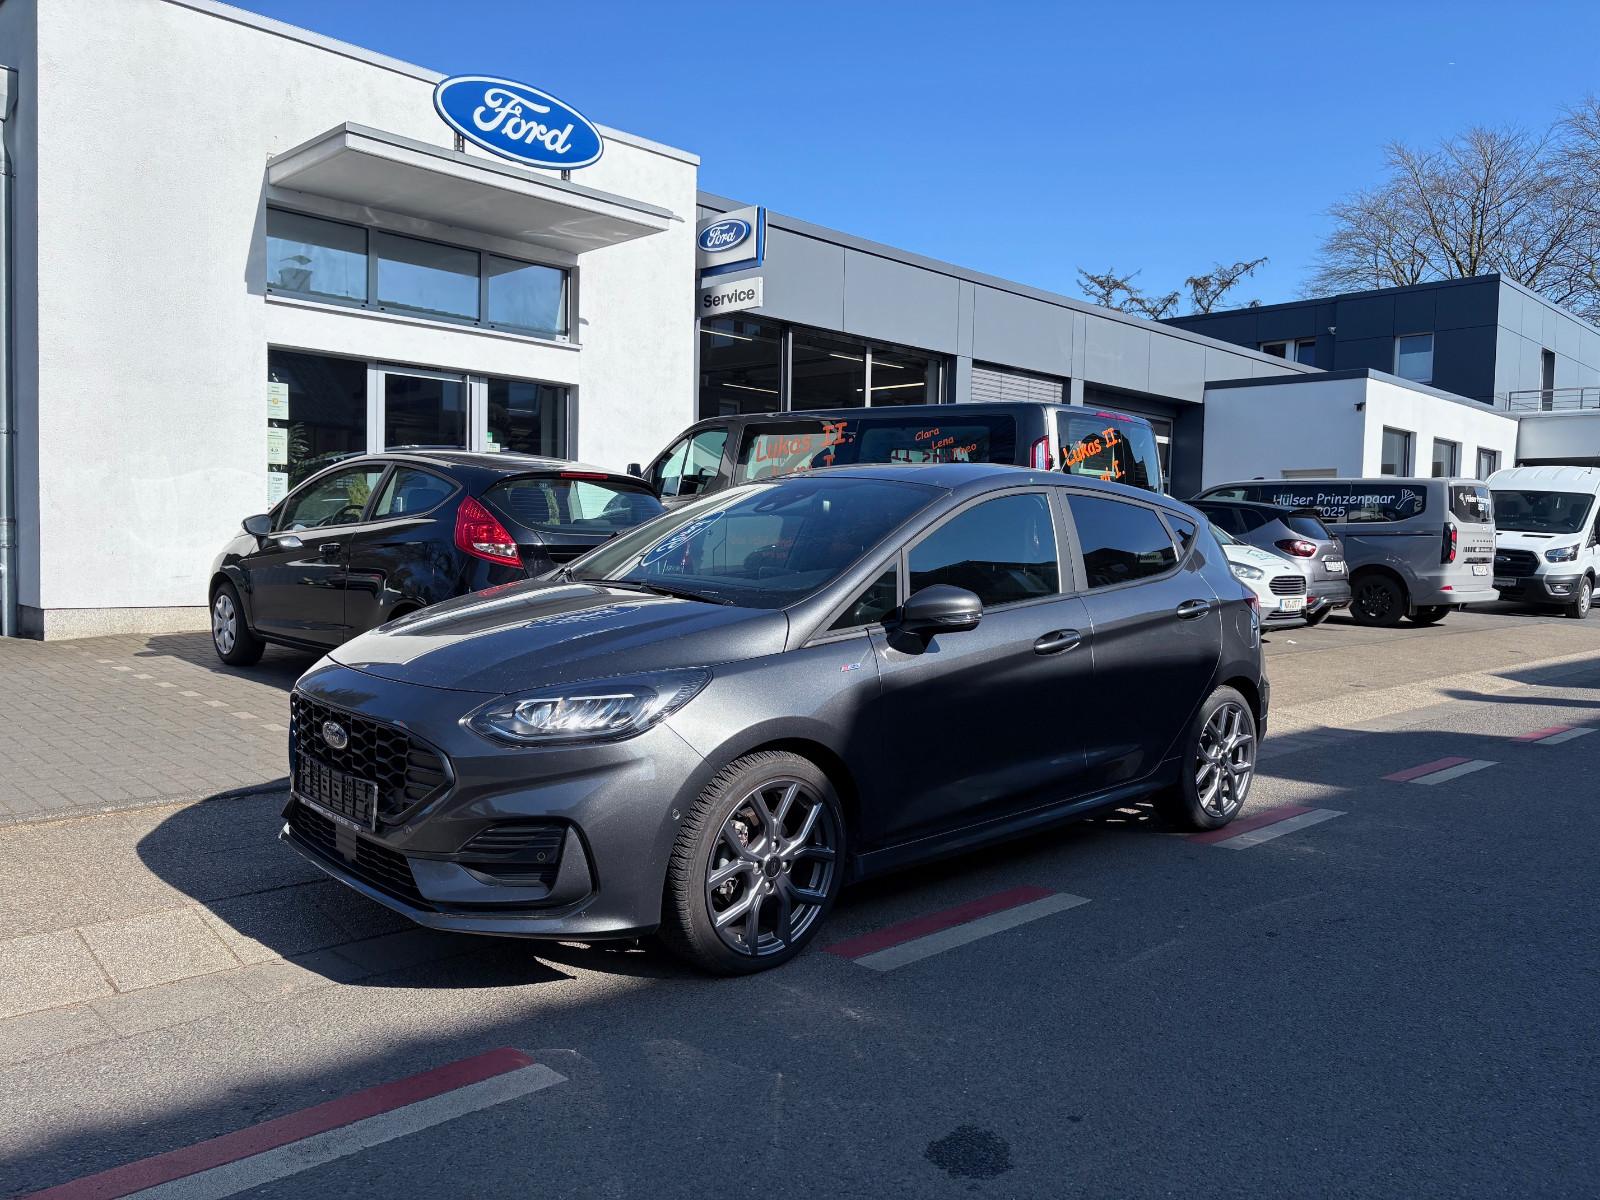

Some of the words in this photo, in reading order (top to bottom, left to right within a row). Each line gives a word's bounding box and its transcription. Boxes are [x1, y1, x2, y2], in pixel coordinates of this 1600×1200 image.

[473, 88, 574, 154] Ford
[706, 224, 737, 247] Ford
[703, 288, 755, 308] Service
[915, 427, 940, 441] Clara
[931, 436, 954, 450] Lena
[756, 435, 812, 462] Lukas
[951, 443, 977, 455] Theo
[1062, 439, 1102, 466] Lukas
[1273, 493, 1314, 506] Hülser
[1317, 493, 1396, 508] Prinzenpaar
